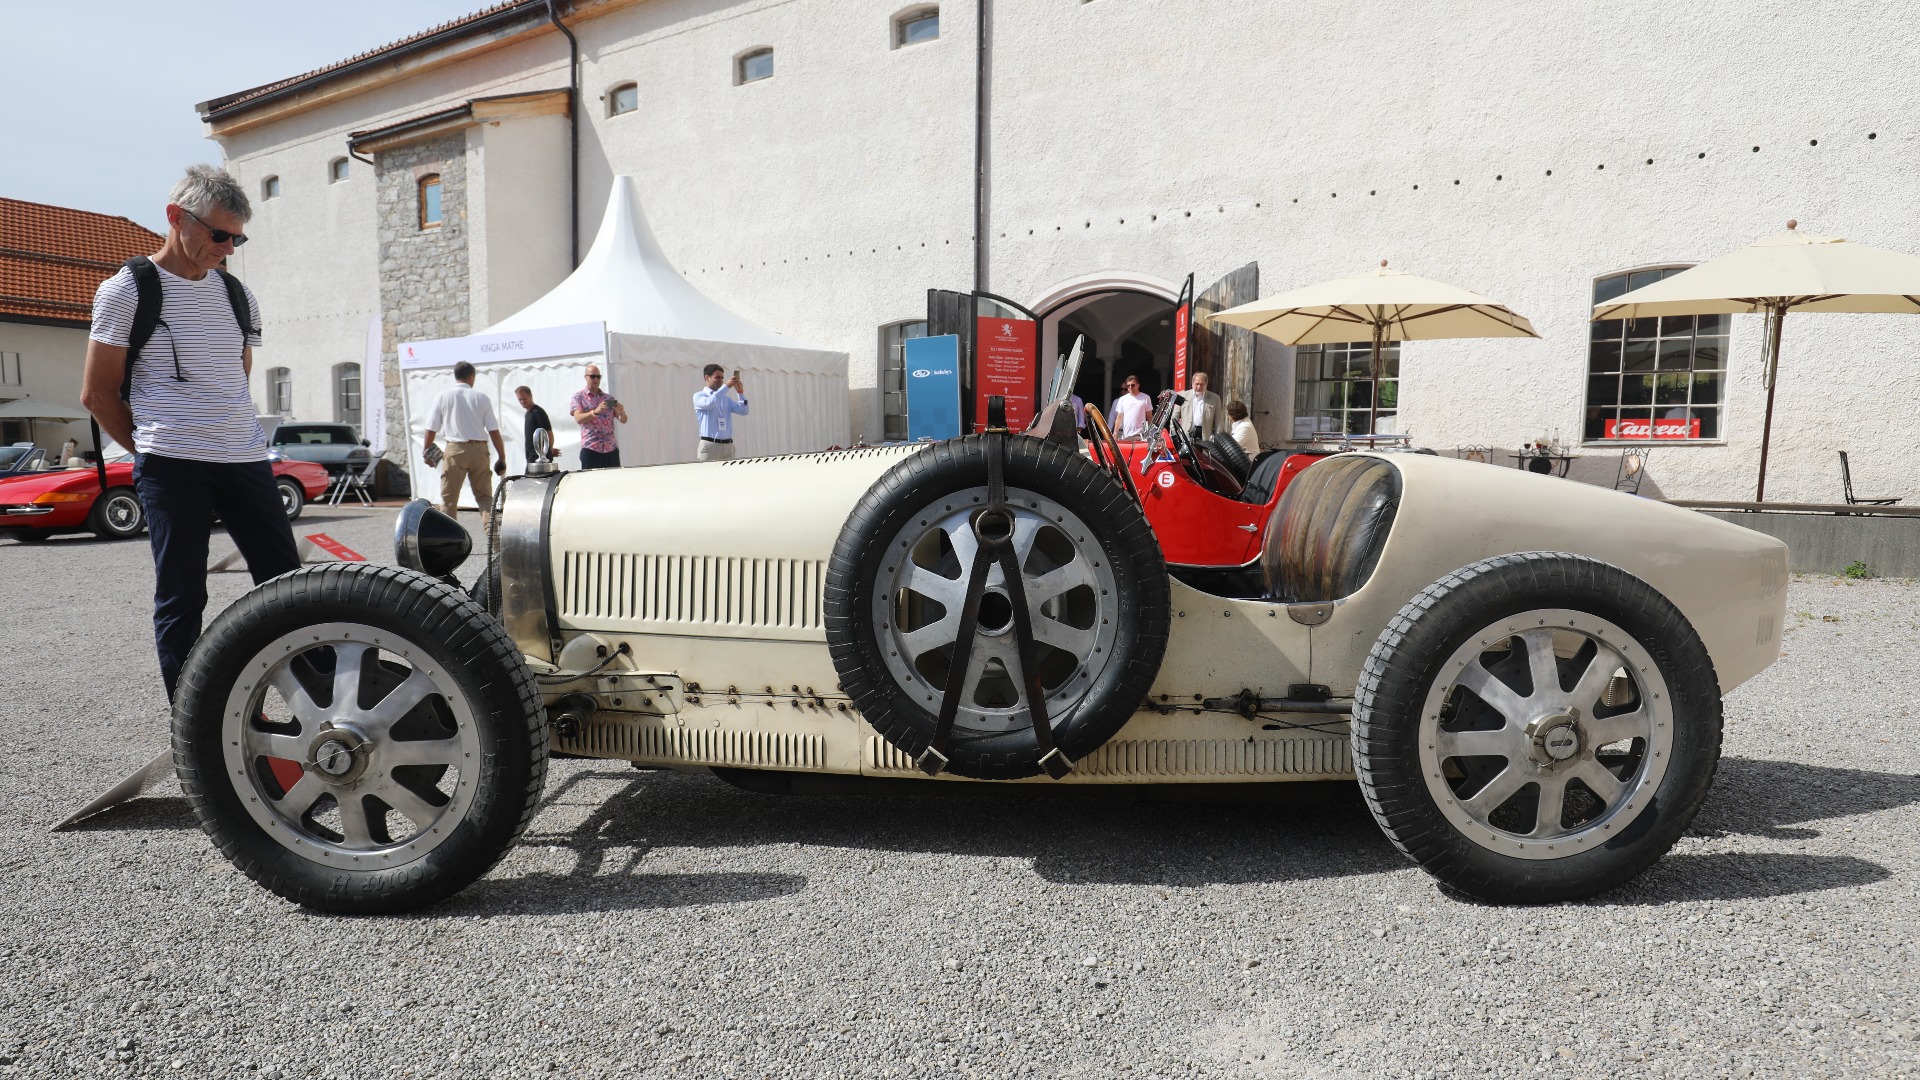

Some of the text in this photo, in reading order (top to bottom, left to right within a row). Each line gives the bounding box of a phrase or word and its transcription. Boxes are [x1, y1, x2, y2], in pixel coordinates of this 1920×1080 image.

[480, 340, 525, 354] KINGA MATHE
[1611, 422, 1693, 436] Carrera
[1162, 473, 1170, 485] E
[360, 865, 425, 893] COMP
